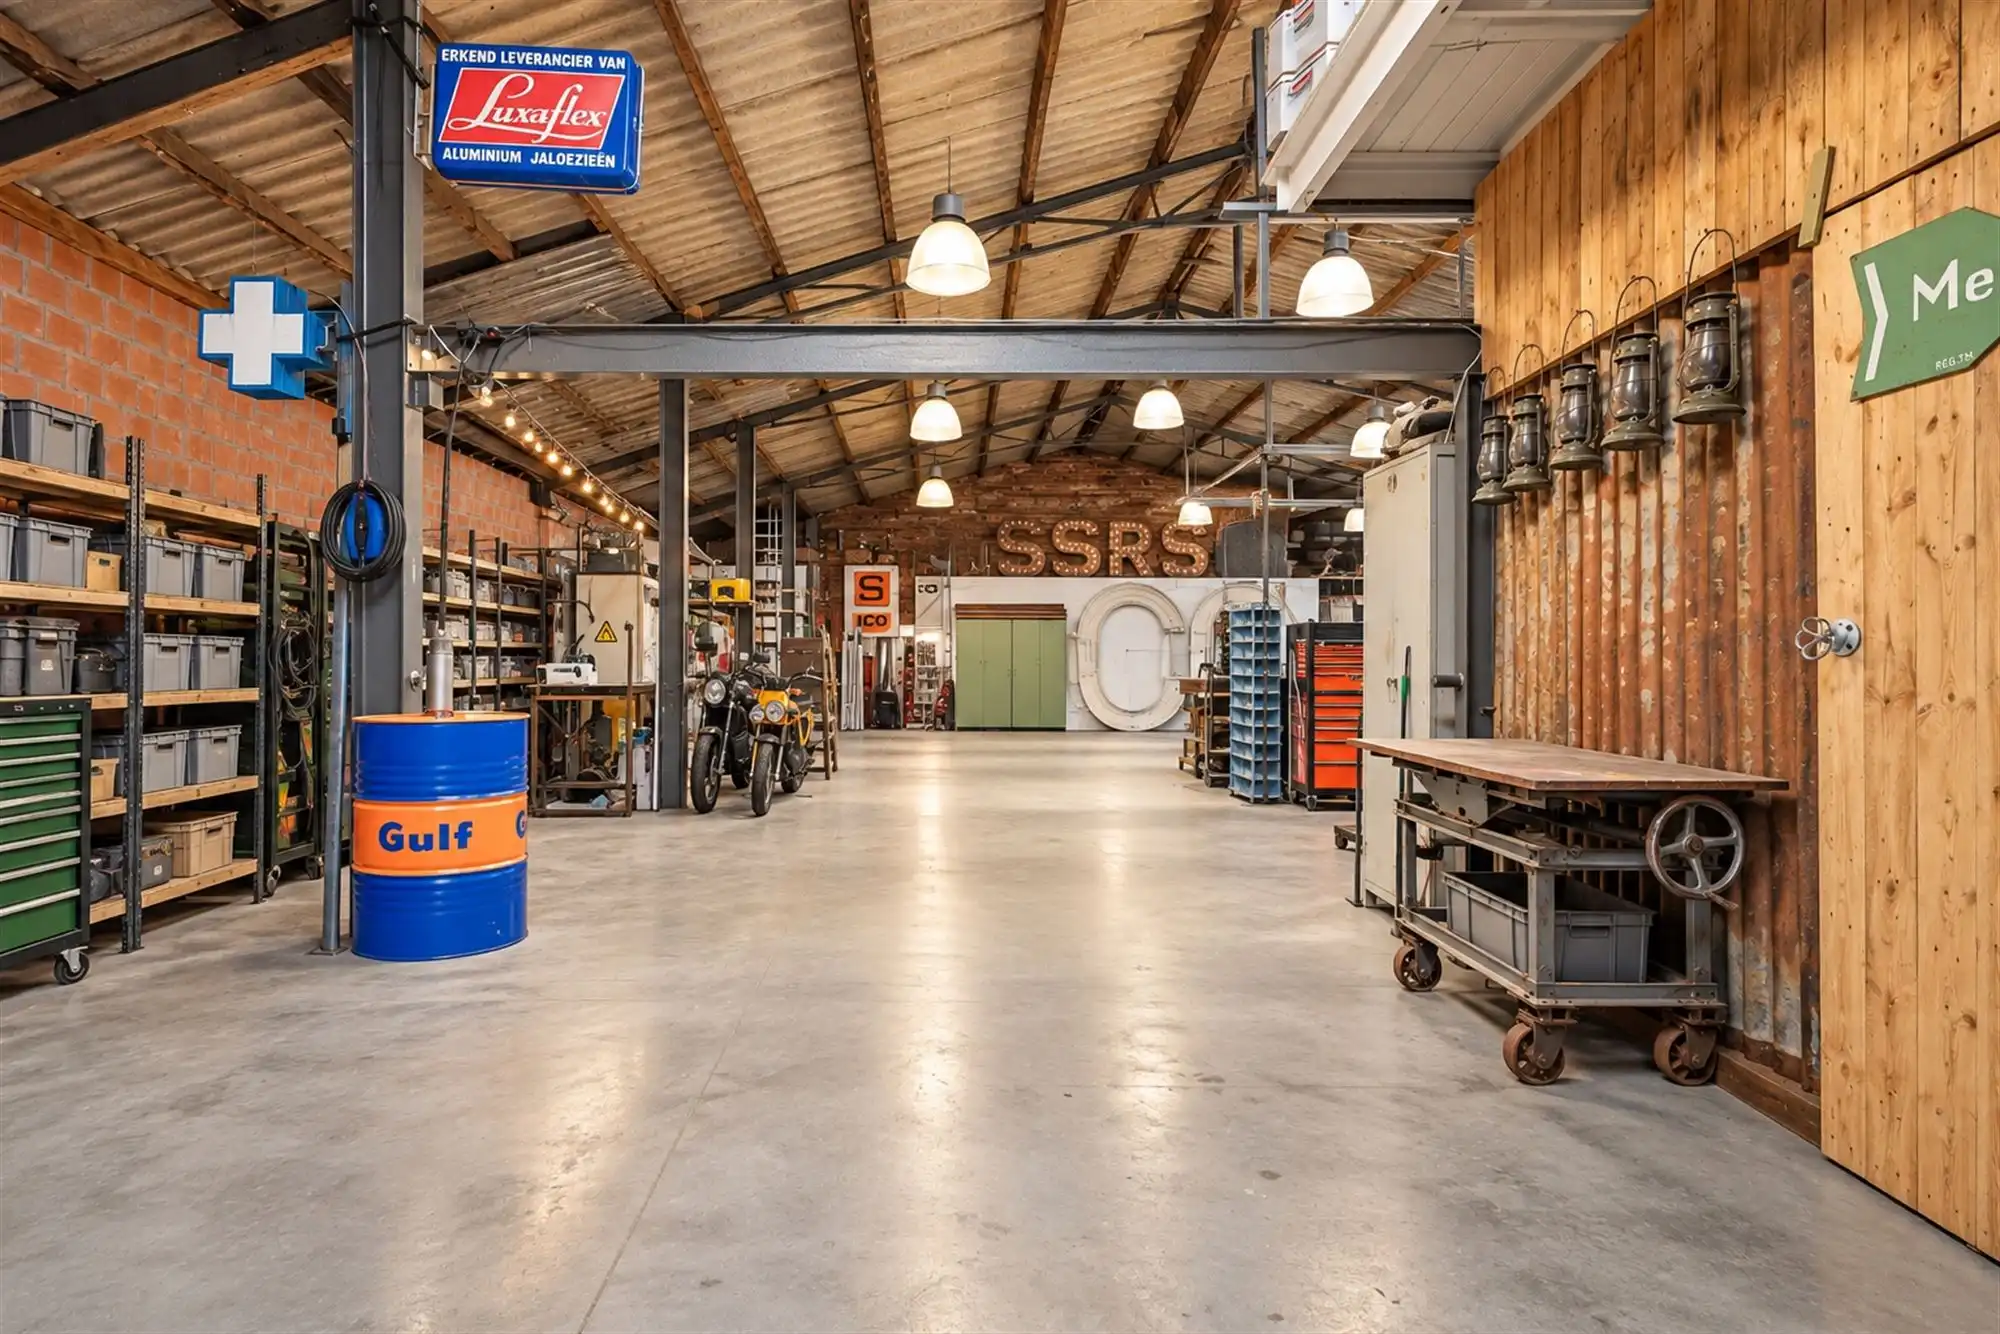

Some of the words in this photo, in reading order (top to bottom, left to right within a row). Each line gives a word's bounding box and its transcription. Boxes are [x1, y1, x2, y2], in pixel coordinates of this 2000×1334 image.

[441, 48, 497, 65] ERKEND
[500, 50, 594, 69] LEVERANCIER
[598, 55, 627, 70] VAN
[448, 72, 608, 145] Luxaflex
[442, 147, 523, 164] ALUMINIUM
[530, 150, 616, 169] JALOEZIEËN
[997, 518, 1210, 577] SSRS
[858, 574, 884, 601] S
[378, 821, 473, 852] Gulf
